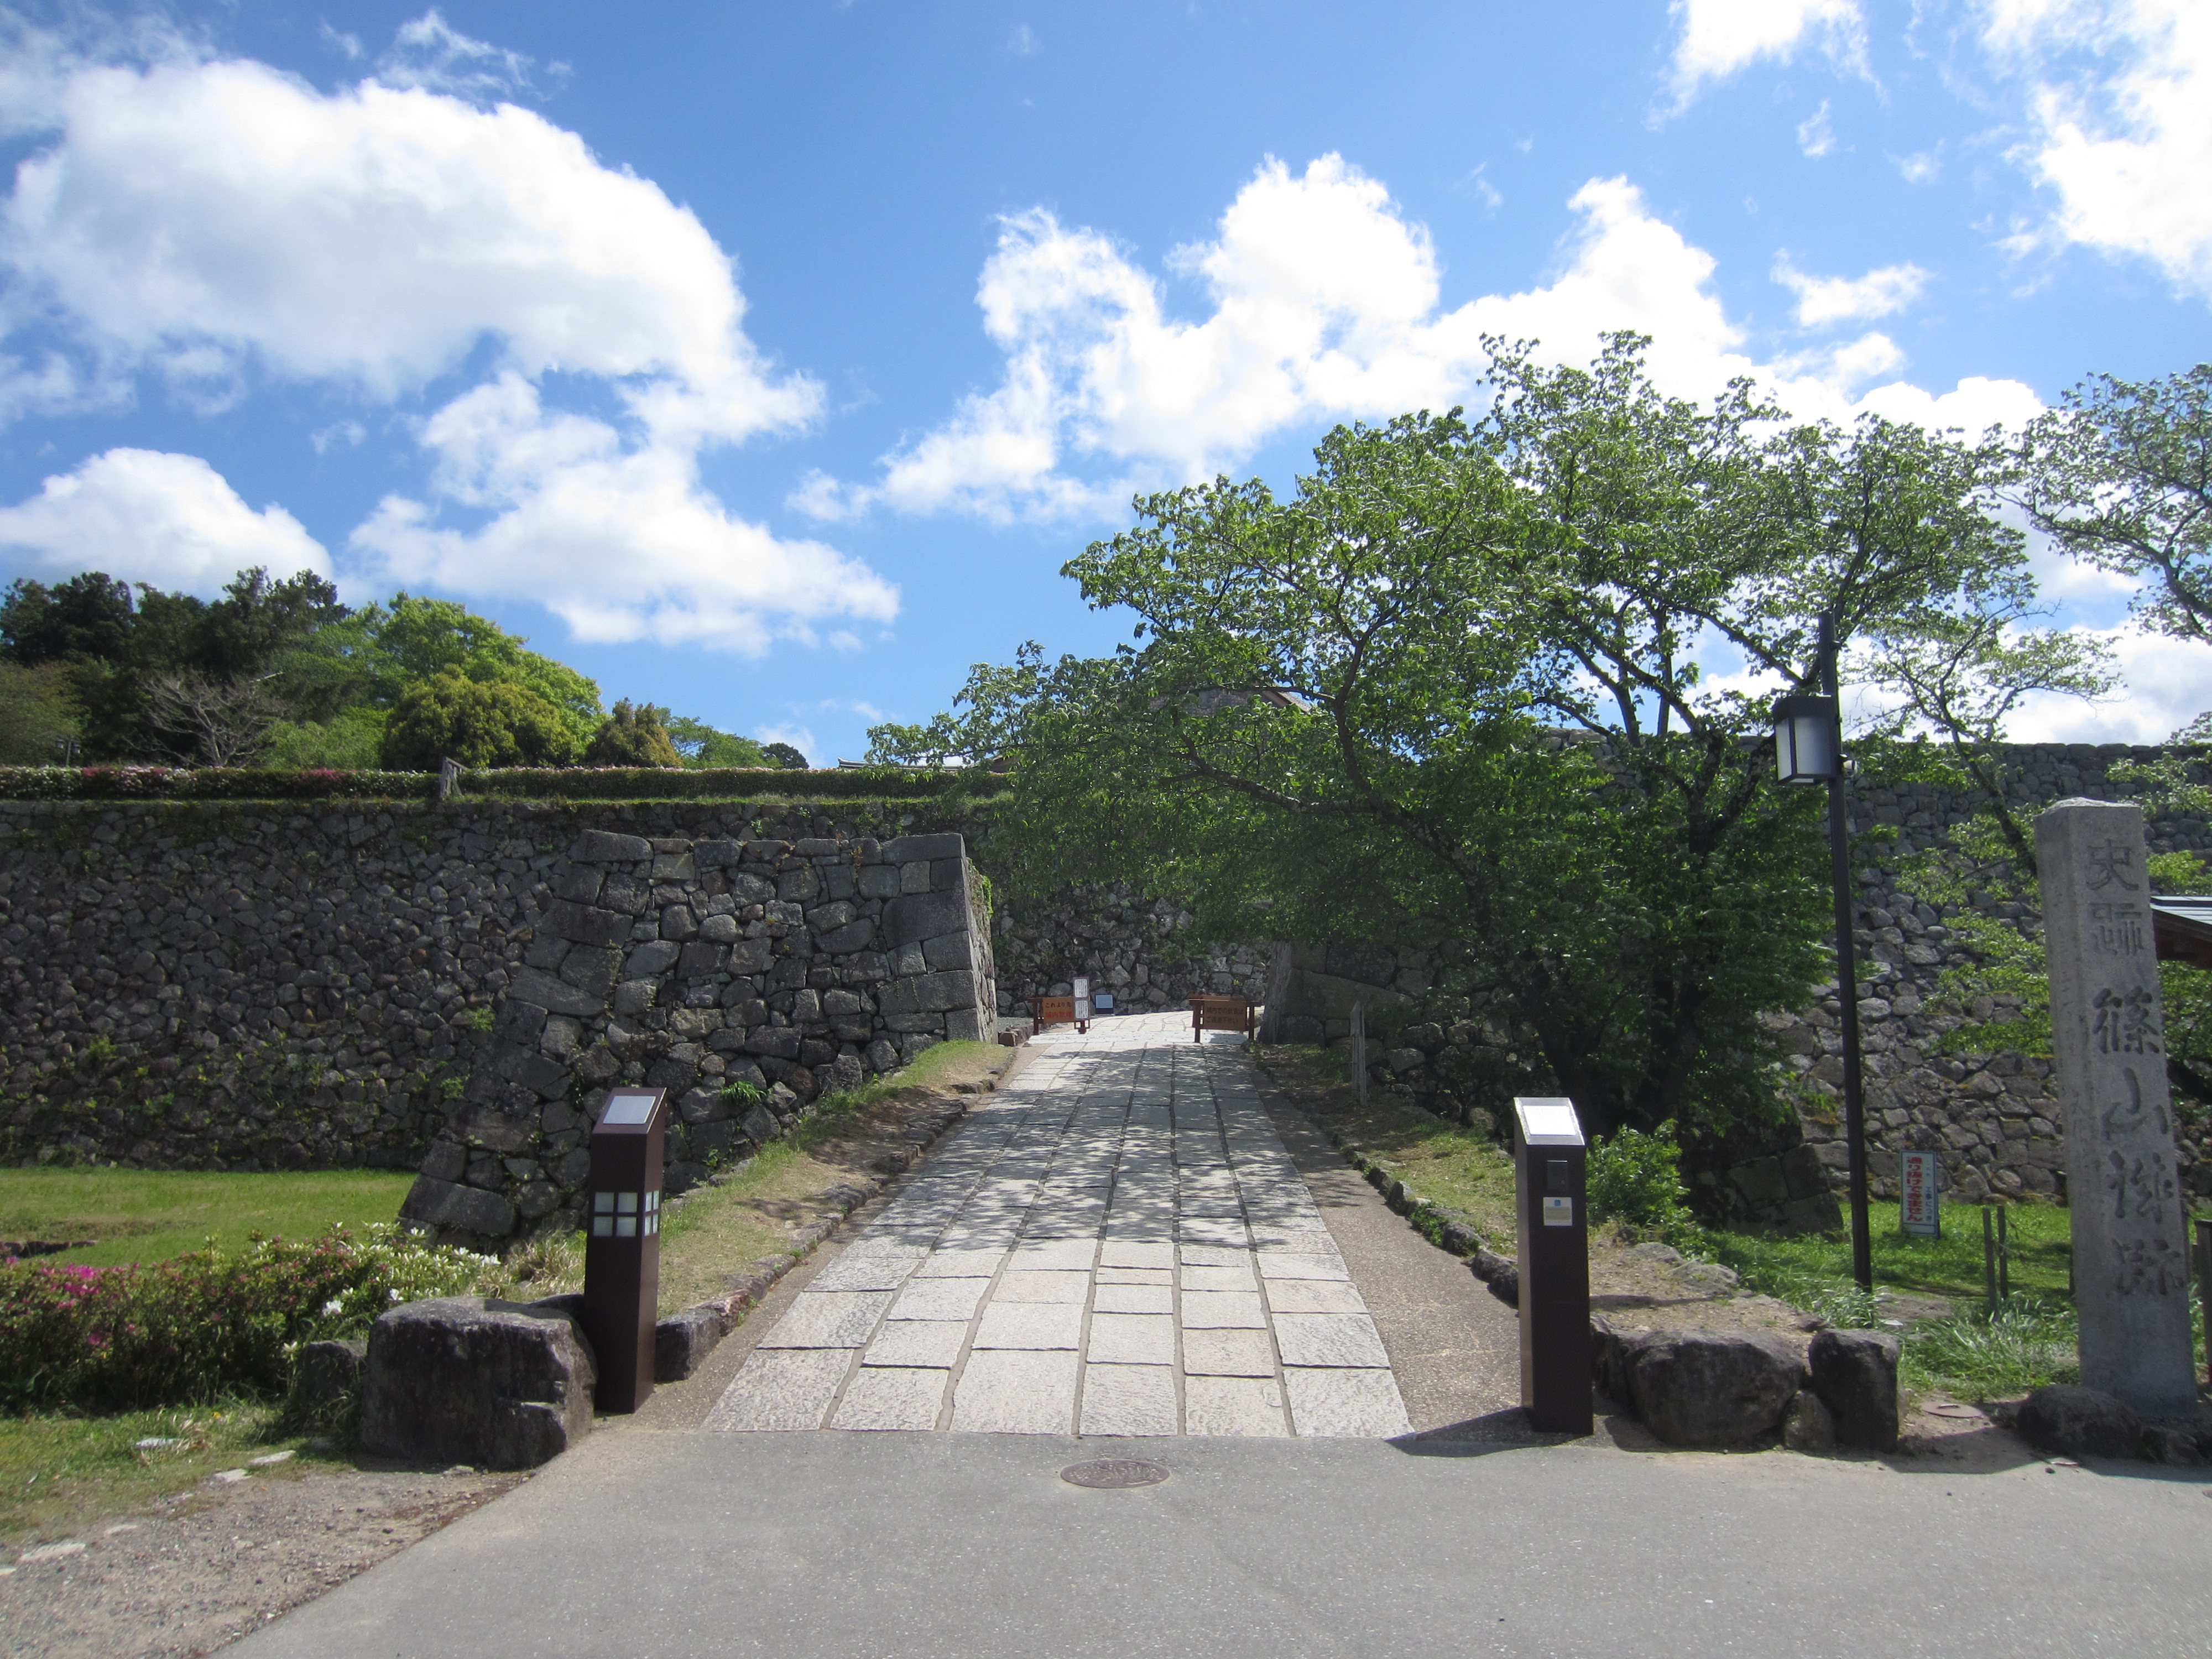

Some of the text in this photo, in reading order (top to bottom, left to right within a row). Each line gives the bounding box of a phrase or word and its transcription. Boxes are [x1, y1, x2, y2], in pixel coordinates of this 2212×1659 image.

[1906, 1156, 1923, 1222] 通り抜けできません
